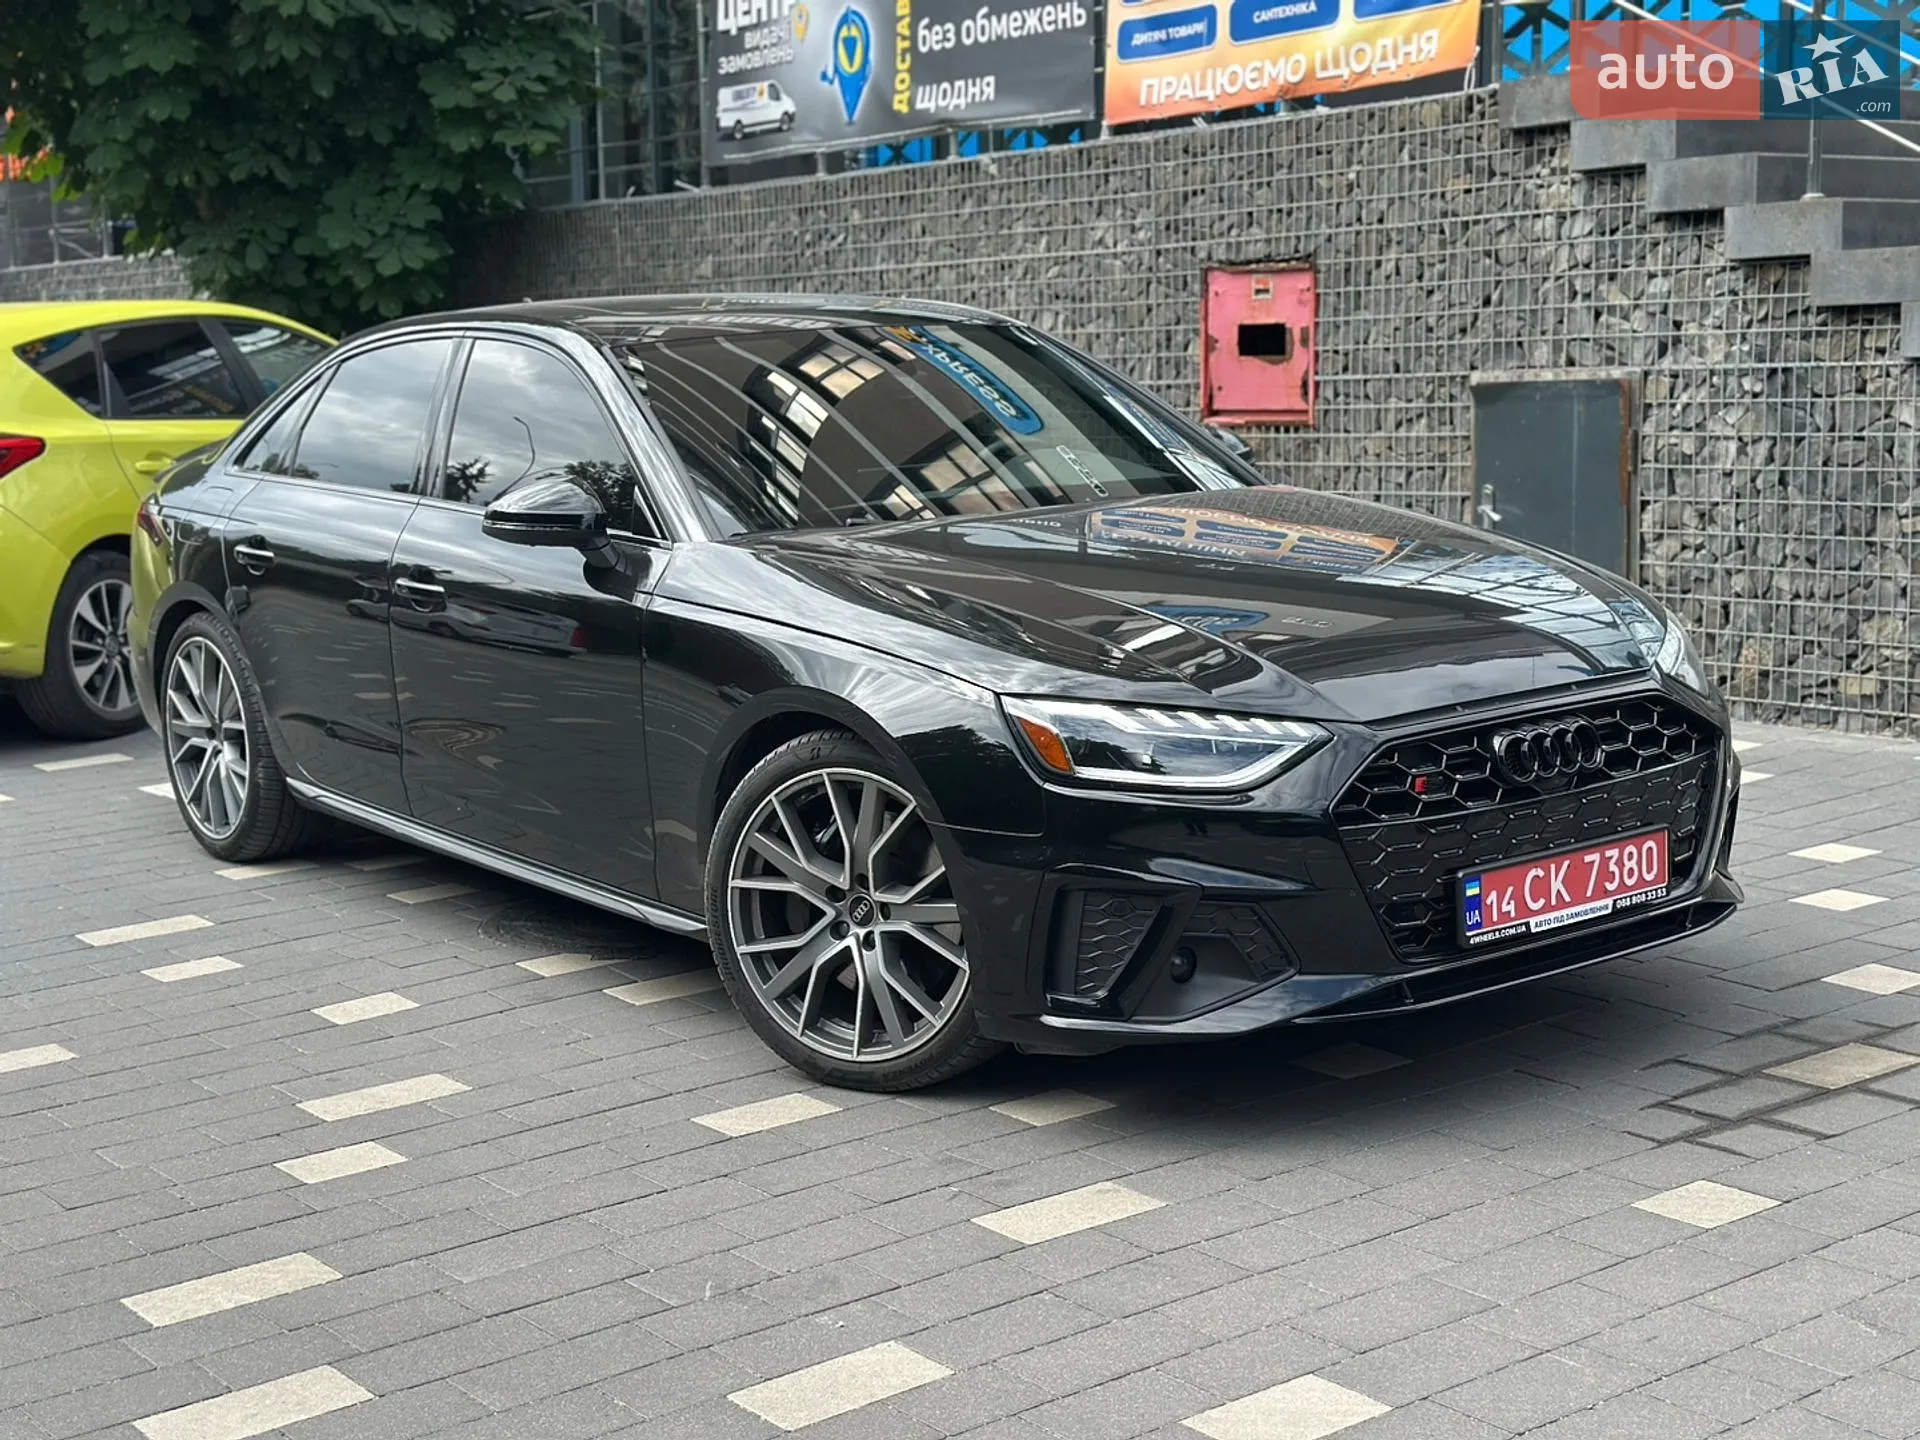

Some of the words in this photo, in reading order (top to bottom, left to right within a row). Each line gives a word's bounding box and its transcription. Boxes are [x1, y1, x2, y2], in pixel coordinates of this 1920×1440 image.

[1253, 1, 1317, 24] САНТЕХНІКА
[917, 16, 956, 54] без
[961, 5, 1087, 46] обмежень
[718, 45, 795, 75] замовлень
[1139, 53, 1307, 106] ПРАЦЮЄМО
[1314, 28, 1440, 81] ЩОДНЯ
[915, 75, 996, 113] щодня
[1485, 886, 1516, 922] 14
[1524, 860, 1571, 911] CK
[1584, 840, 1658, 897] 7380
[1466, 910, 1481, 926] UA
[1534, 917, 1552, 929] АВТО
[1553, 914, 1566, 925] ПІД
[1565, 903, 1610, 921] ЗАМОВЛЕННЯ
[1469, 924, 1527, 945] 4WHEELS.COM.UA
